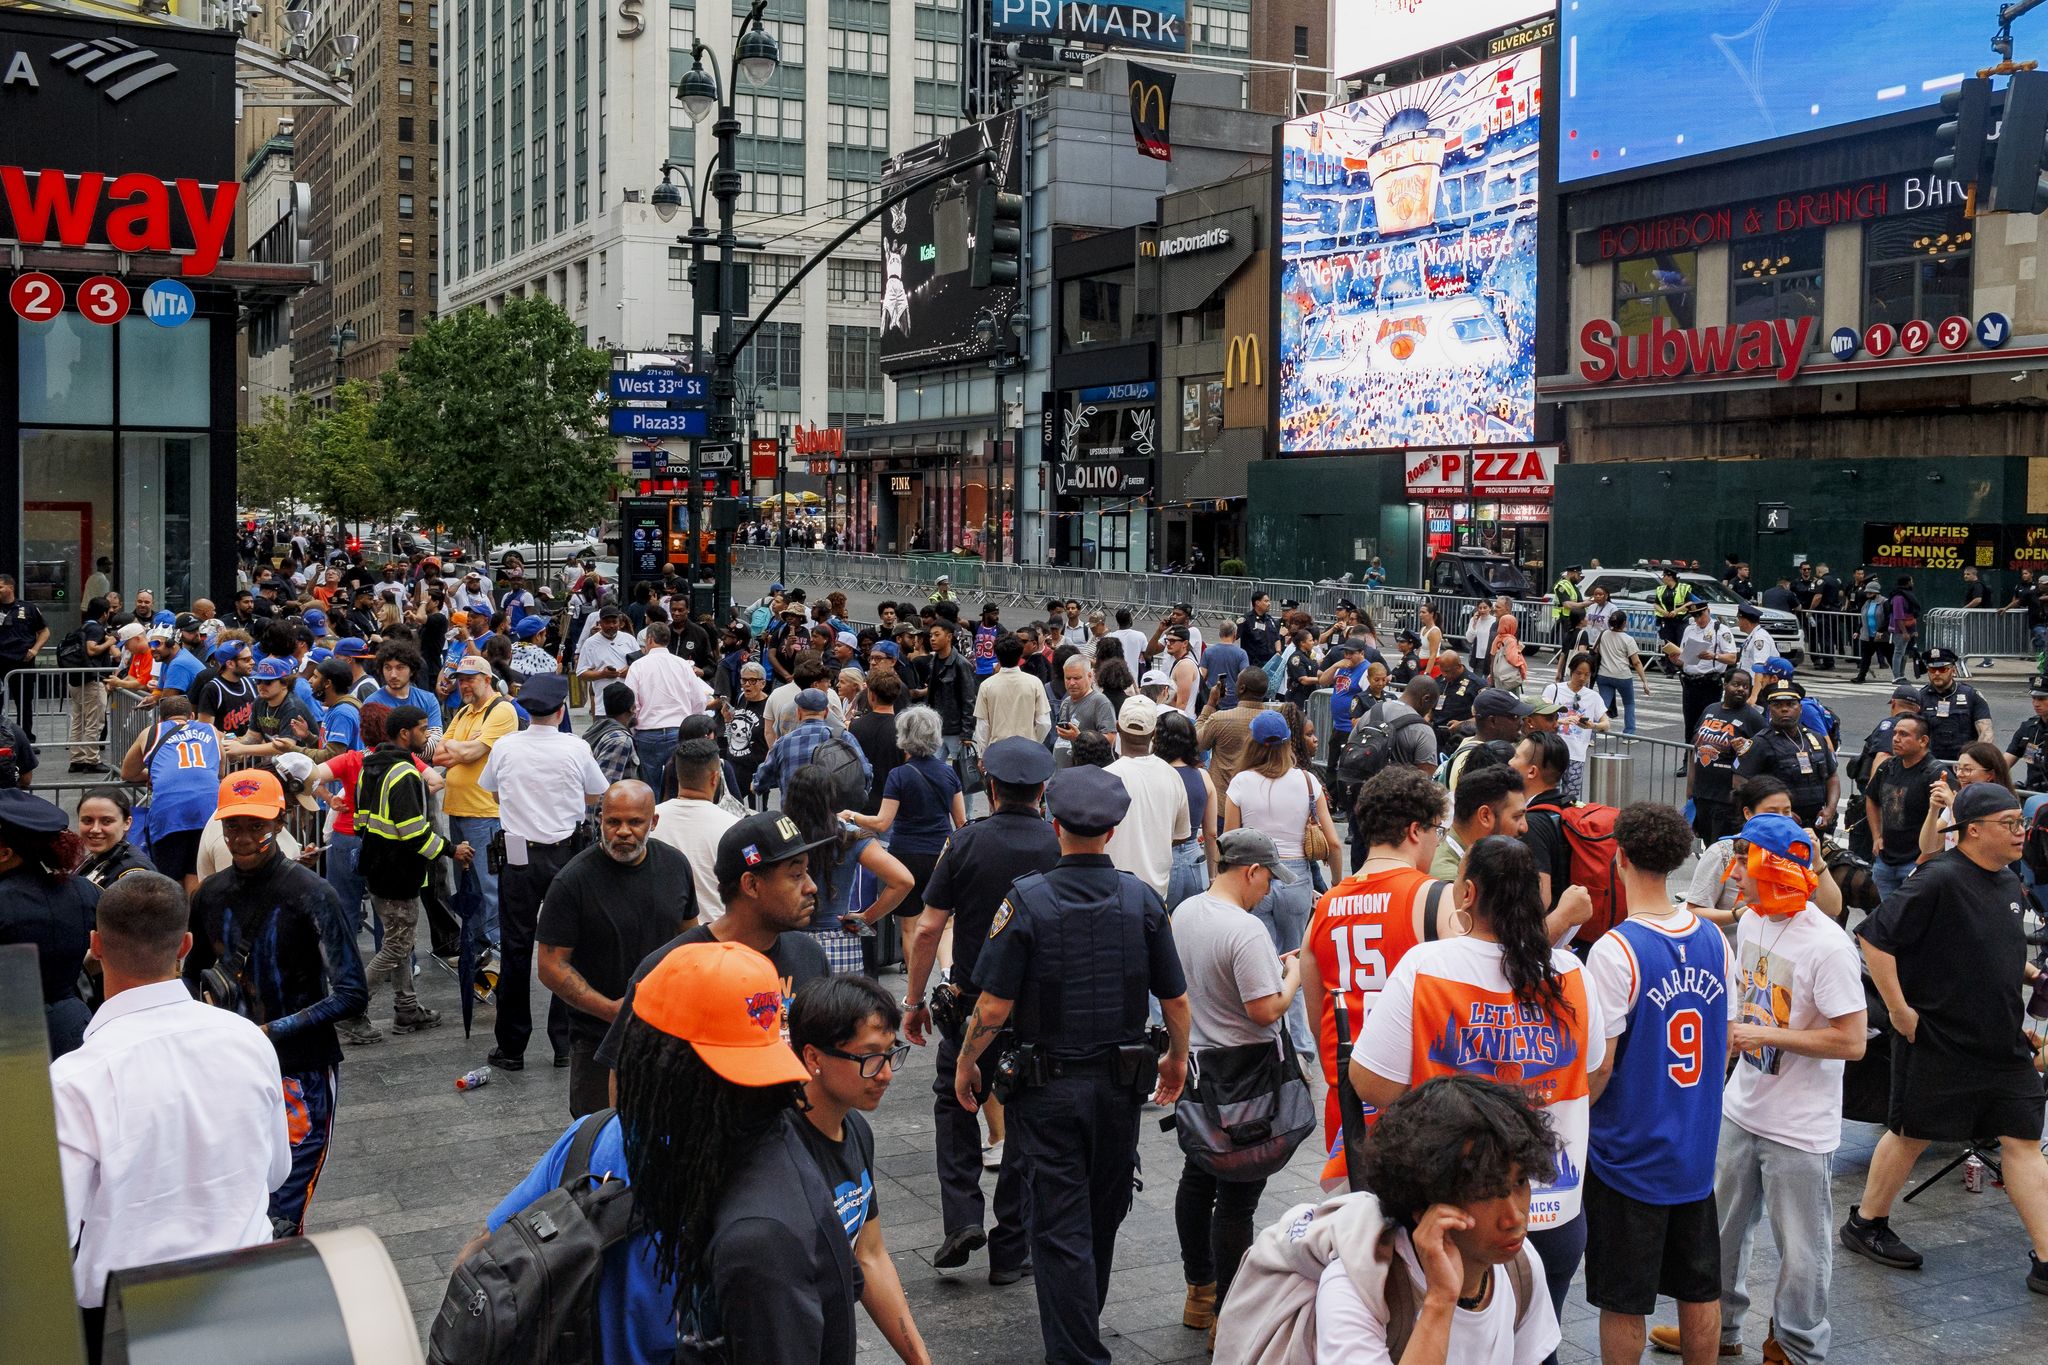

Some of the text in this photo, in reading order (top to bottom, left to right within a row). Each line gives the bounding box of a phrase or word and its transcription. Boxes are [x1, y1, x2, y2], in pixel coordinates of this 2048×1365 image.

[1003, 0, 1177, 43] PRIMARK
[1600, 208, 1731, 259] BOURBON
[1744, 207, 1761, 233] &
[1776, 182, 1888, 231] BRANCH
[1159, 228, 1230, 257] McDonald's
[1302, 230, 1514, 288] New York or Nowhere
[24, 283, 190, 318] 2 3 MTA
[1580, 316, 1815, 383] Subway
[1830, 322, 1961, 354] MTA 1 2 3
[618, 378, 701, 395] West 33rd St
[633, 414, 686, 430] Plaza33
[1044, 412, 1053, 441] OLIYO
[795, 423, 843, 458] Subway
[703, 451, 732, 462] ONE WAY
[1406, 453, 1440, 484] ROSE'S
[1441, 448, 1546, 482] PZZA
[891, 477, 911, 491] PINK
[1076, 466, 1118, 489] OLIYO
[1429, 508, 1450, 519] PIZZA
[1906, 526, 1969, 538] FLUFFIES
[1871, 556, 1965, 569] SPRING 2027
[1877, 545, 1958, 559] OPENING
[2014, 548, 2048, 561] OPEN
[223, 702, 254, 731] Knick
[1701, 719, 1735, 737] NBA
[1695, 726, 1729, 748] Finals
[176, 741, 207, 769] 11
[1327, 892, 1392, 917] ANTHONY
[1330, 923, 1388, 993] 15
[1647, 966, 1726, 1012] BARRETT
[1519, 1000, 1545, 1024] GO
[1456, 1024, 1558, 1066] KNICKS
[1667, 1007, 1704, 1089] 9
[1529, 1213, 1557, 1223] INALS
